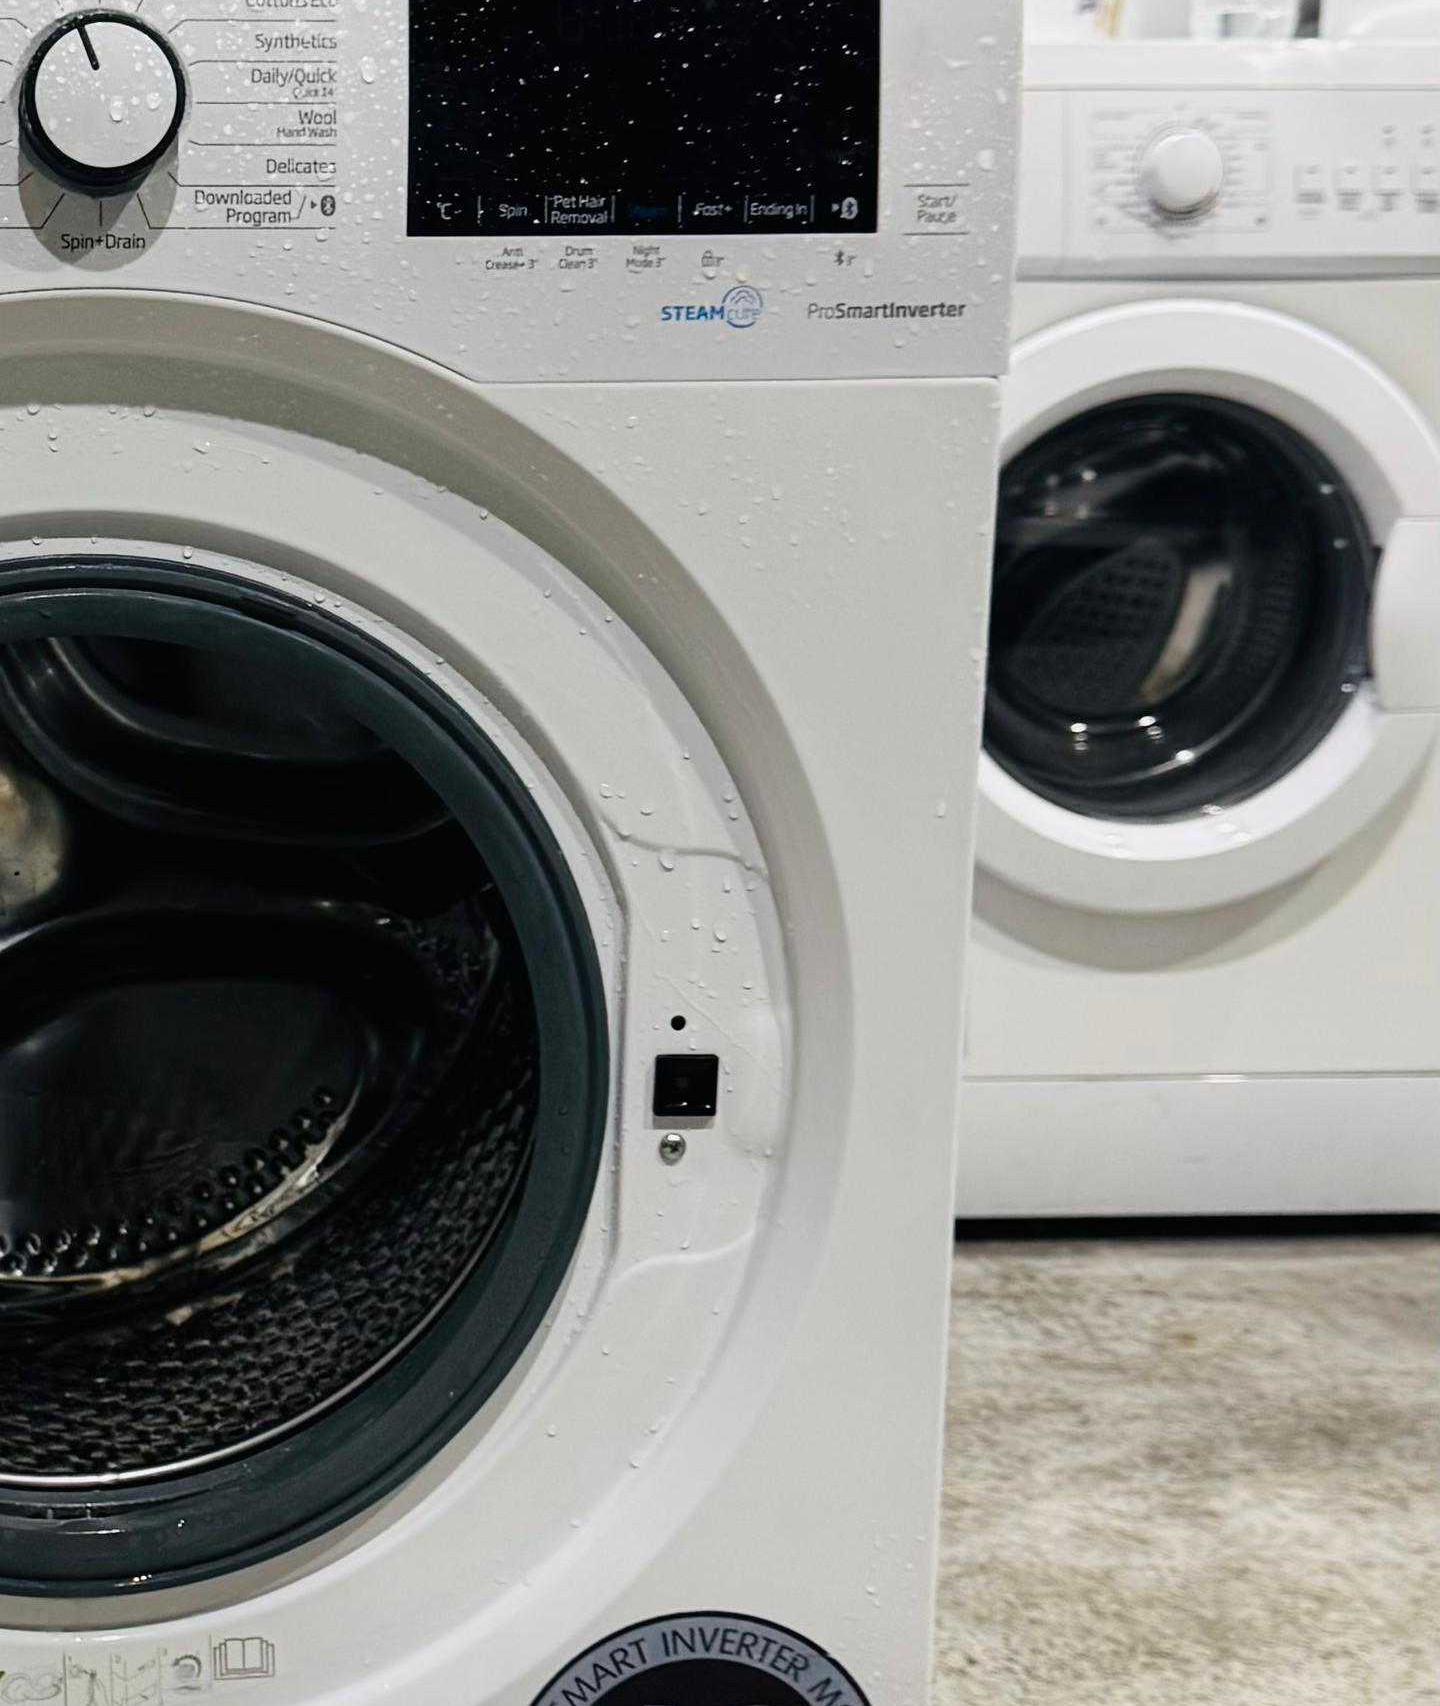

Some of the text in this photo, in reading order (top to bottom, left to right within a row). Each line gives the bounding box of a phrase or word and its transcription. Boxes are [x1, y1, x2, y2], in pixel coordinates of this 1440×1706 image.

[255, 33, 338, 52] Synthetics
[251, 68, 337, 87] Daily/Quick
[299, 110, 337, 125] Wool
[277, 127, 337, 138] Hand Wash
[266, 159, 337, 175] Delicates
[194, 189, 292, 206] Downloaded
[553, 195, 606, 209] Pet Hair
[227, 208, 291, 227] Program
[498, 203, 528, 220] Spin
[551, 211, 608, 224] Removal
[750, 203, 794, 220] Ending
[917, 210, 957, 224] Pause
[61, 233, 146, 253] Spin+Drain
[565, 246, 593, 256] Drum
[633, 246, 660, 257] Night
[559, 259, 585, 270] Clean
[626, 258, 654, 268] Mode
[808, 301, 966, 320] ProSmartInverter
[660, 1627, 810, 1683] INVERTER
